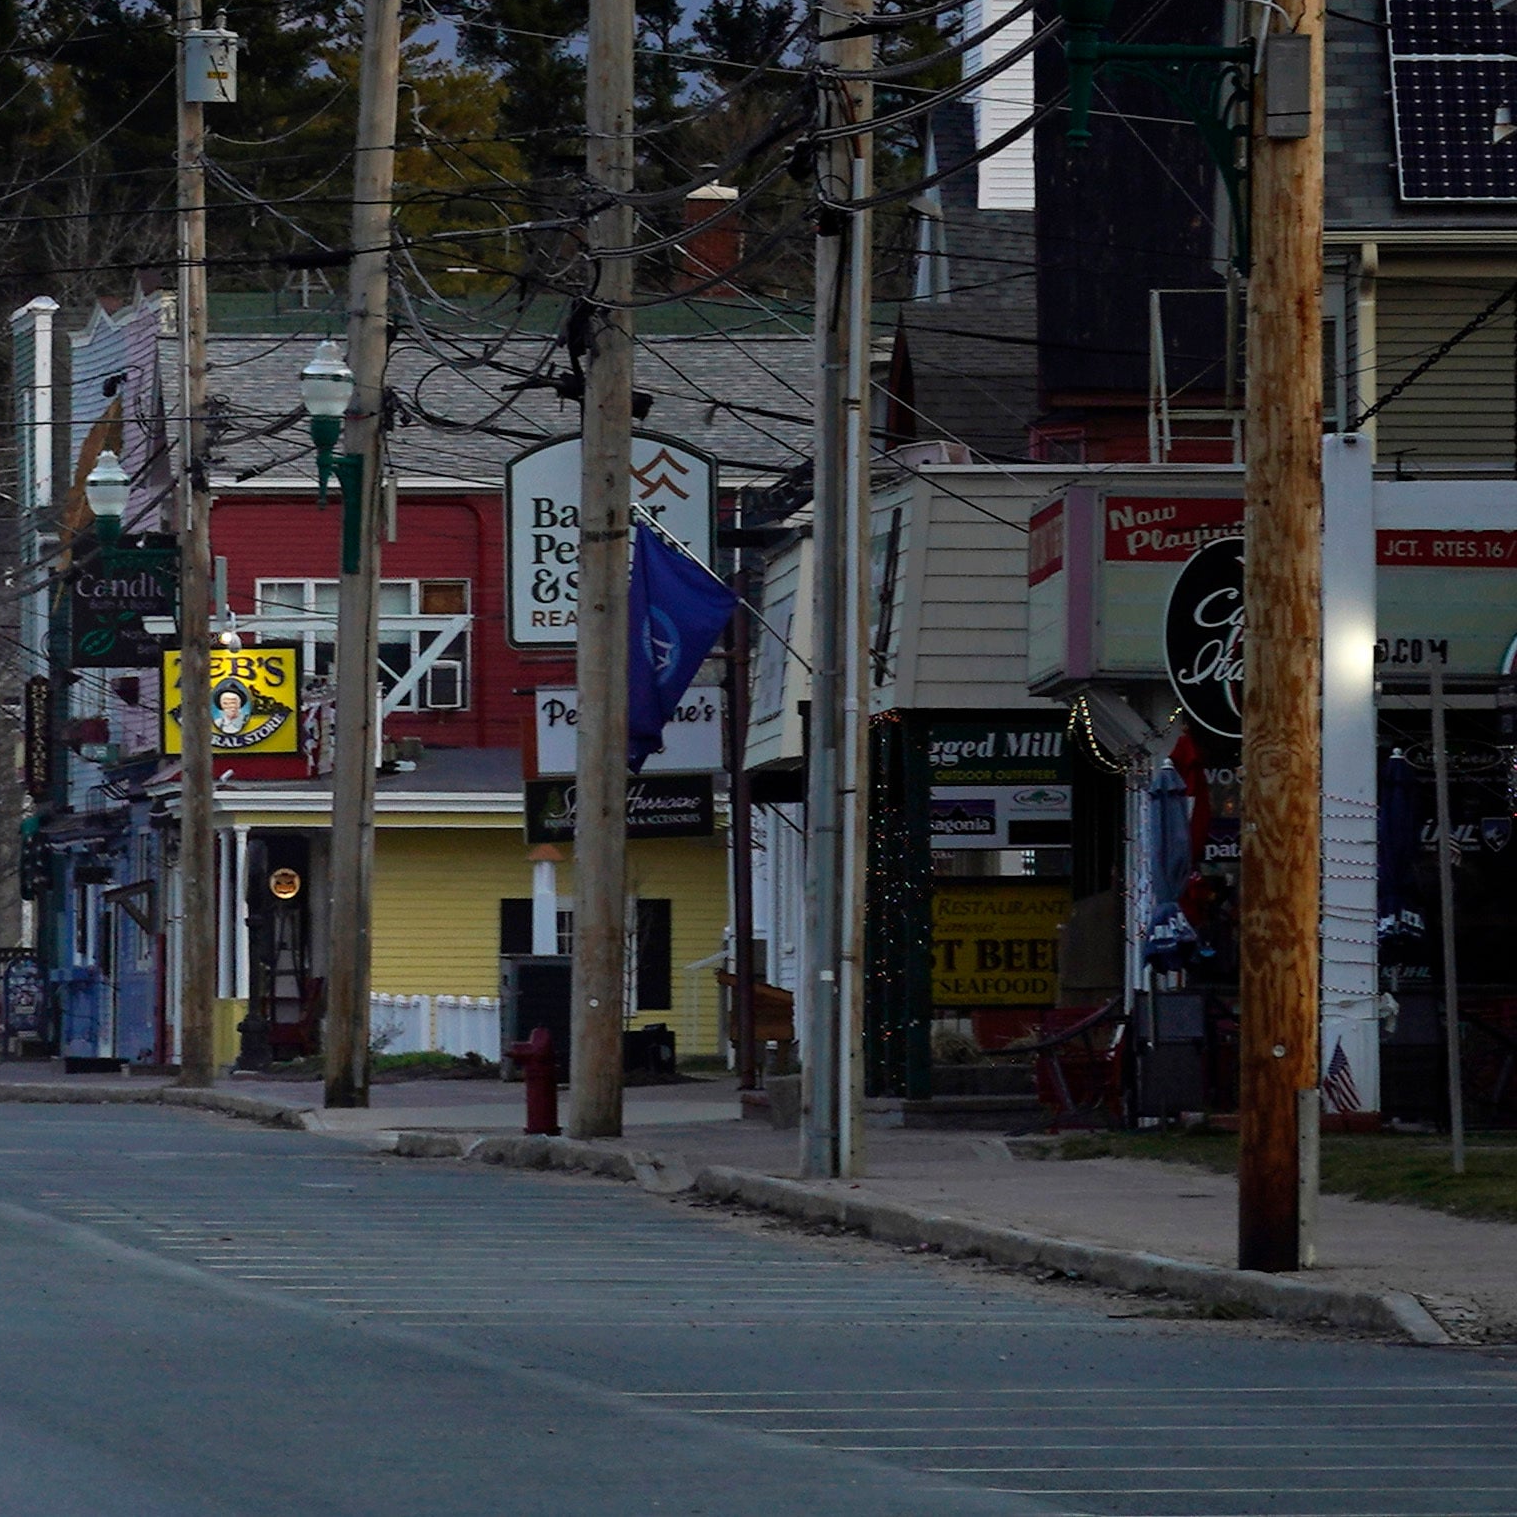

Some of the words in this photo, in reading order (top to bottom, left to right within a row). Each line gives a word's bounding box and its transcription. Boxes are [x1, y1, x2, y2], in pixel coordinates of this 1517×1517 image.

[1108, 504, 1178, 531] Now
[1383, 539, 1424, 557] JCT.
[244, 712, 286, 744] STORE
[1002, 732, 1063, 758] Mill
[934, 769, 993, 781] OUTDOOR
[994, 769, 1058, 781] OUTFITTERS
[938, 898, 1068, 915] RESTAURANT
[939, 978, 1048, 994] SEAFOOD
